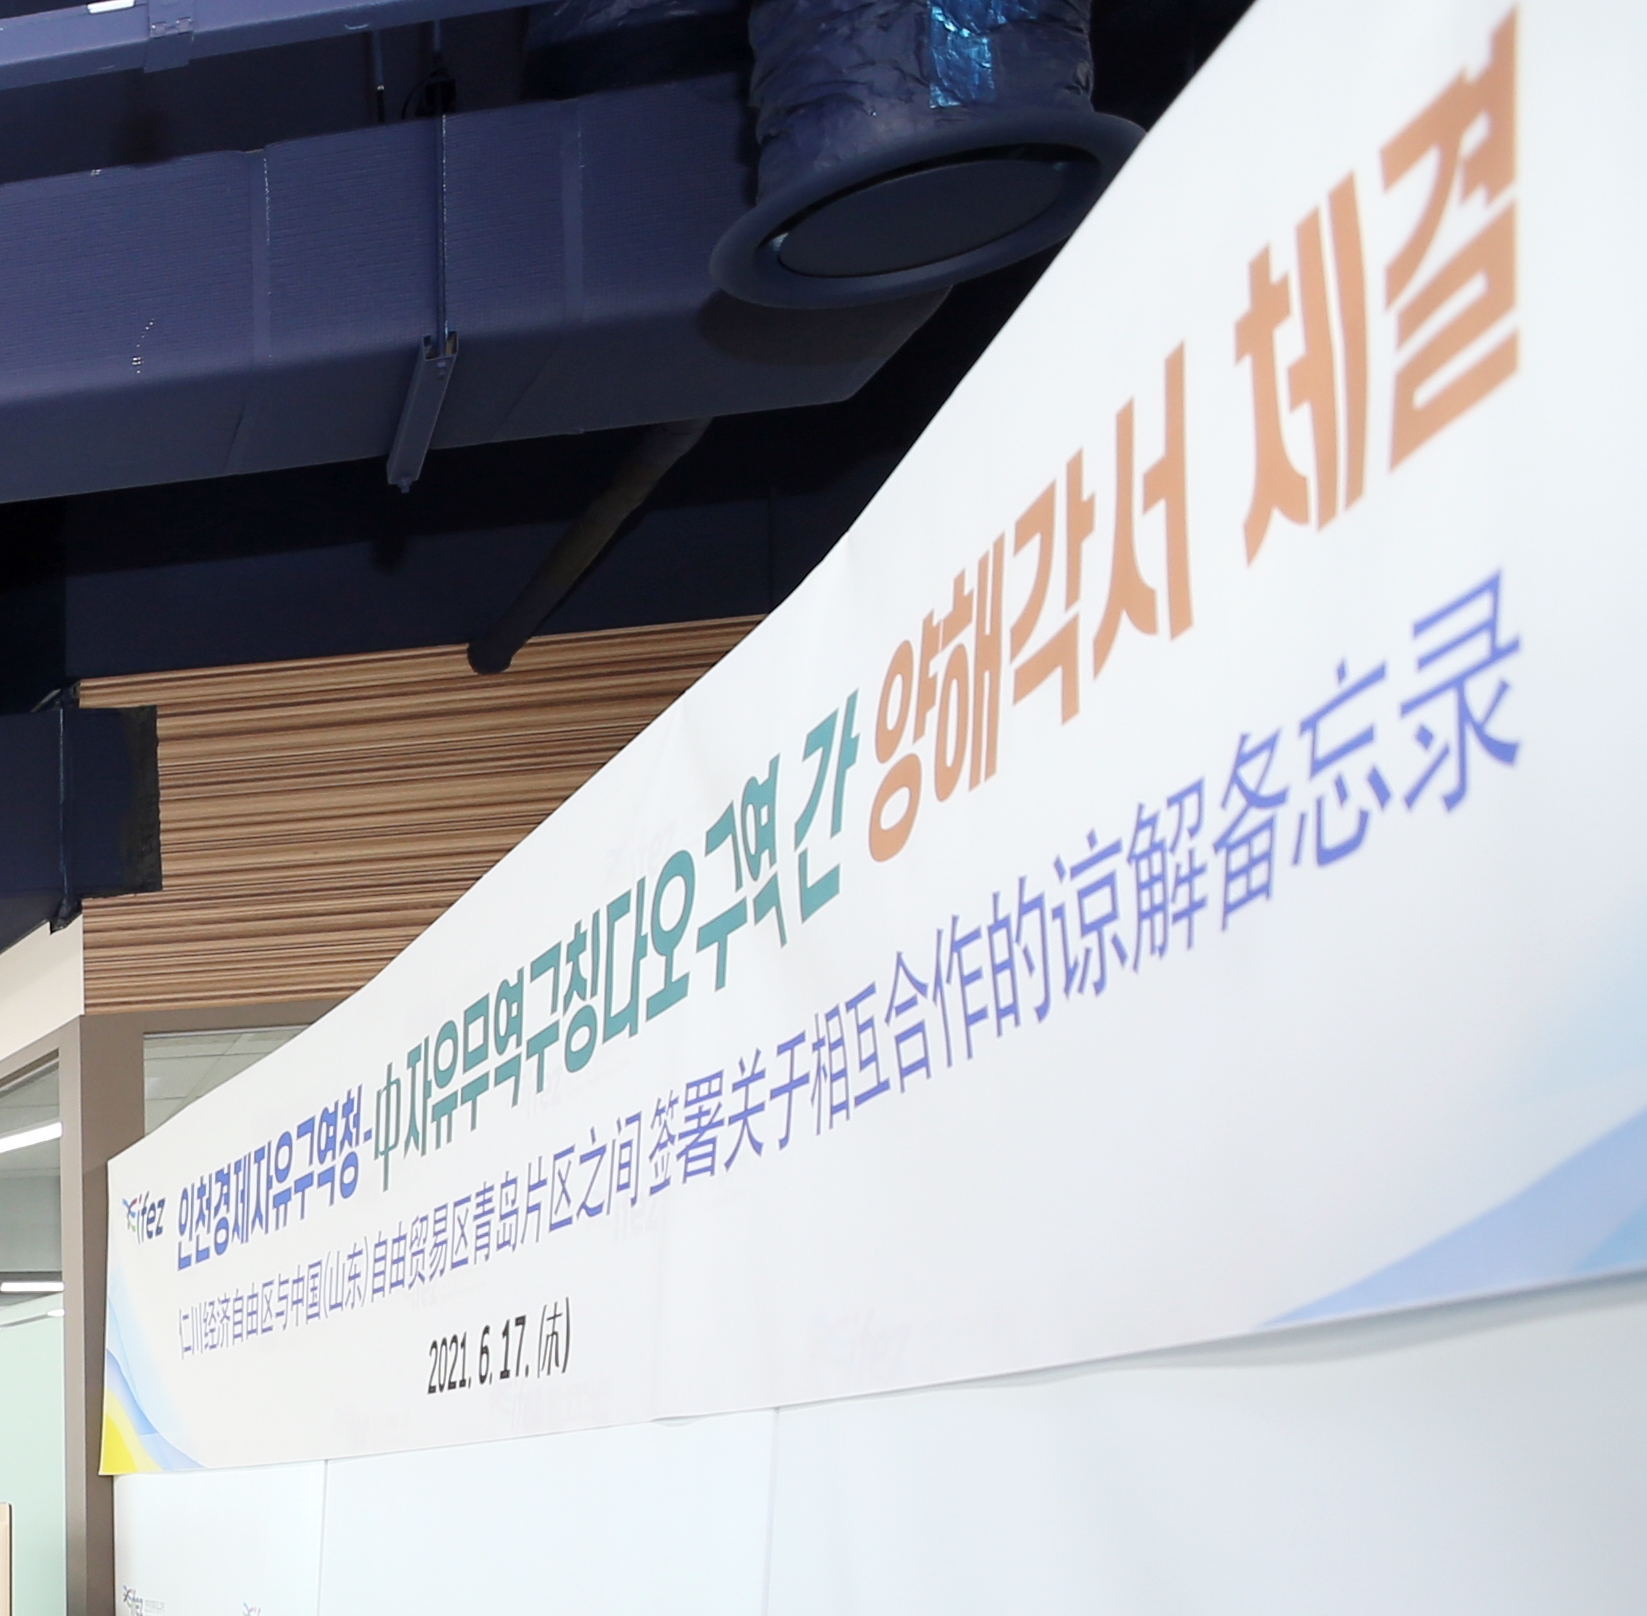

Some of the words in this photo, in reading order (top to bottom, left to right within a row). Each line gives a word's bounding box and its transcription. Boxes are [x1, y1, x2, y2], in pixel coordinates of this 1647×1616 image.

[868, 339, 1195, 864] 양해각서
[1233, 8, 1520, 568] 체결
[136, 1190, 166, 1245] ifez
